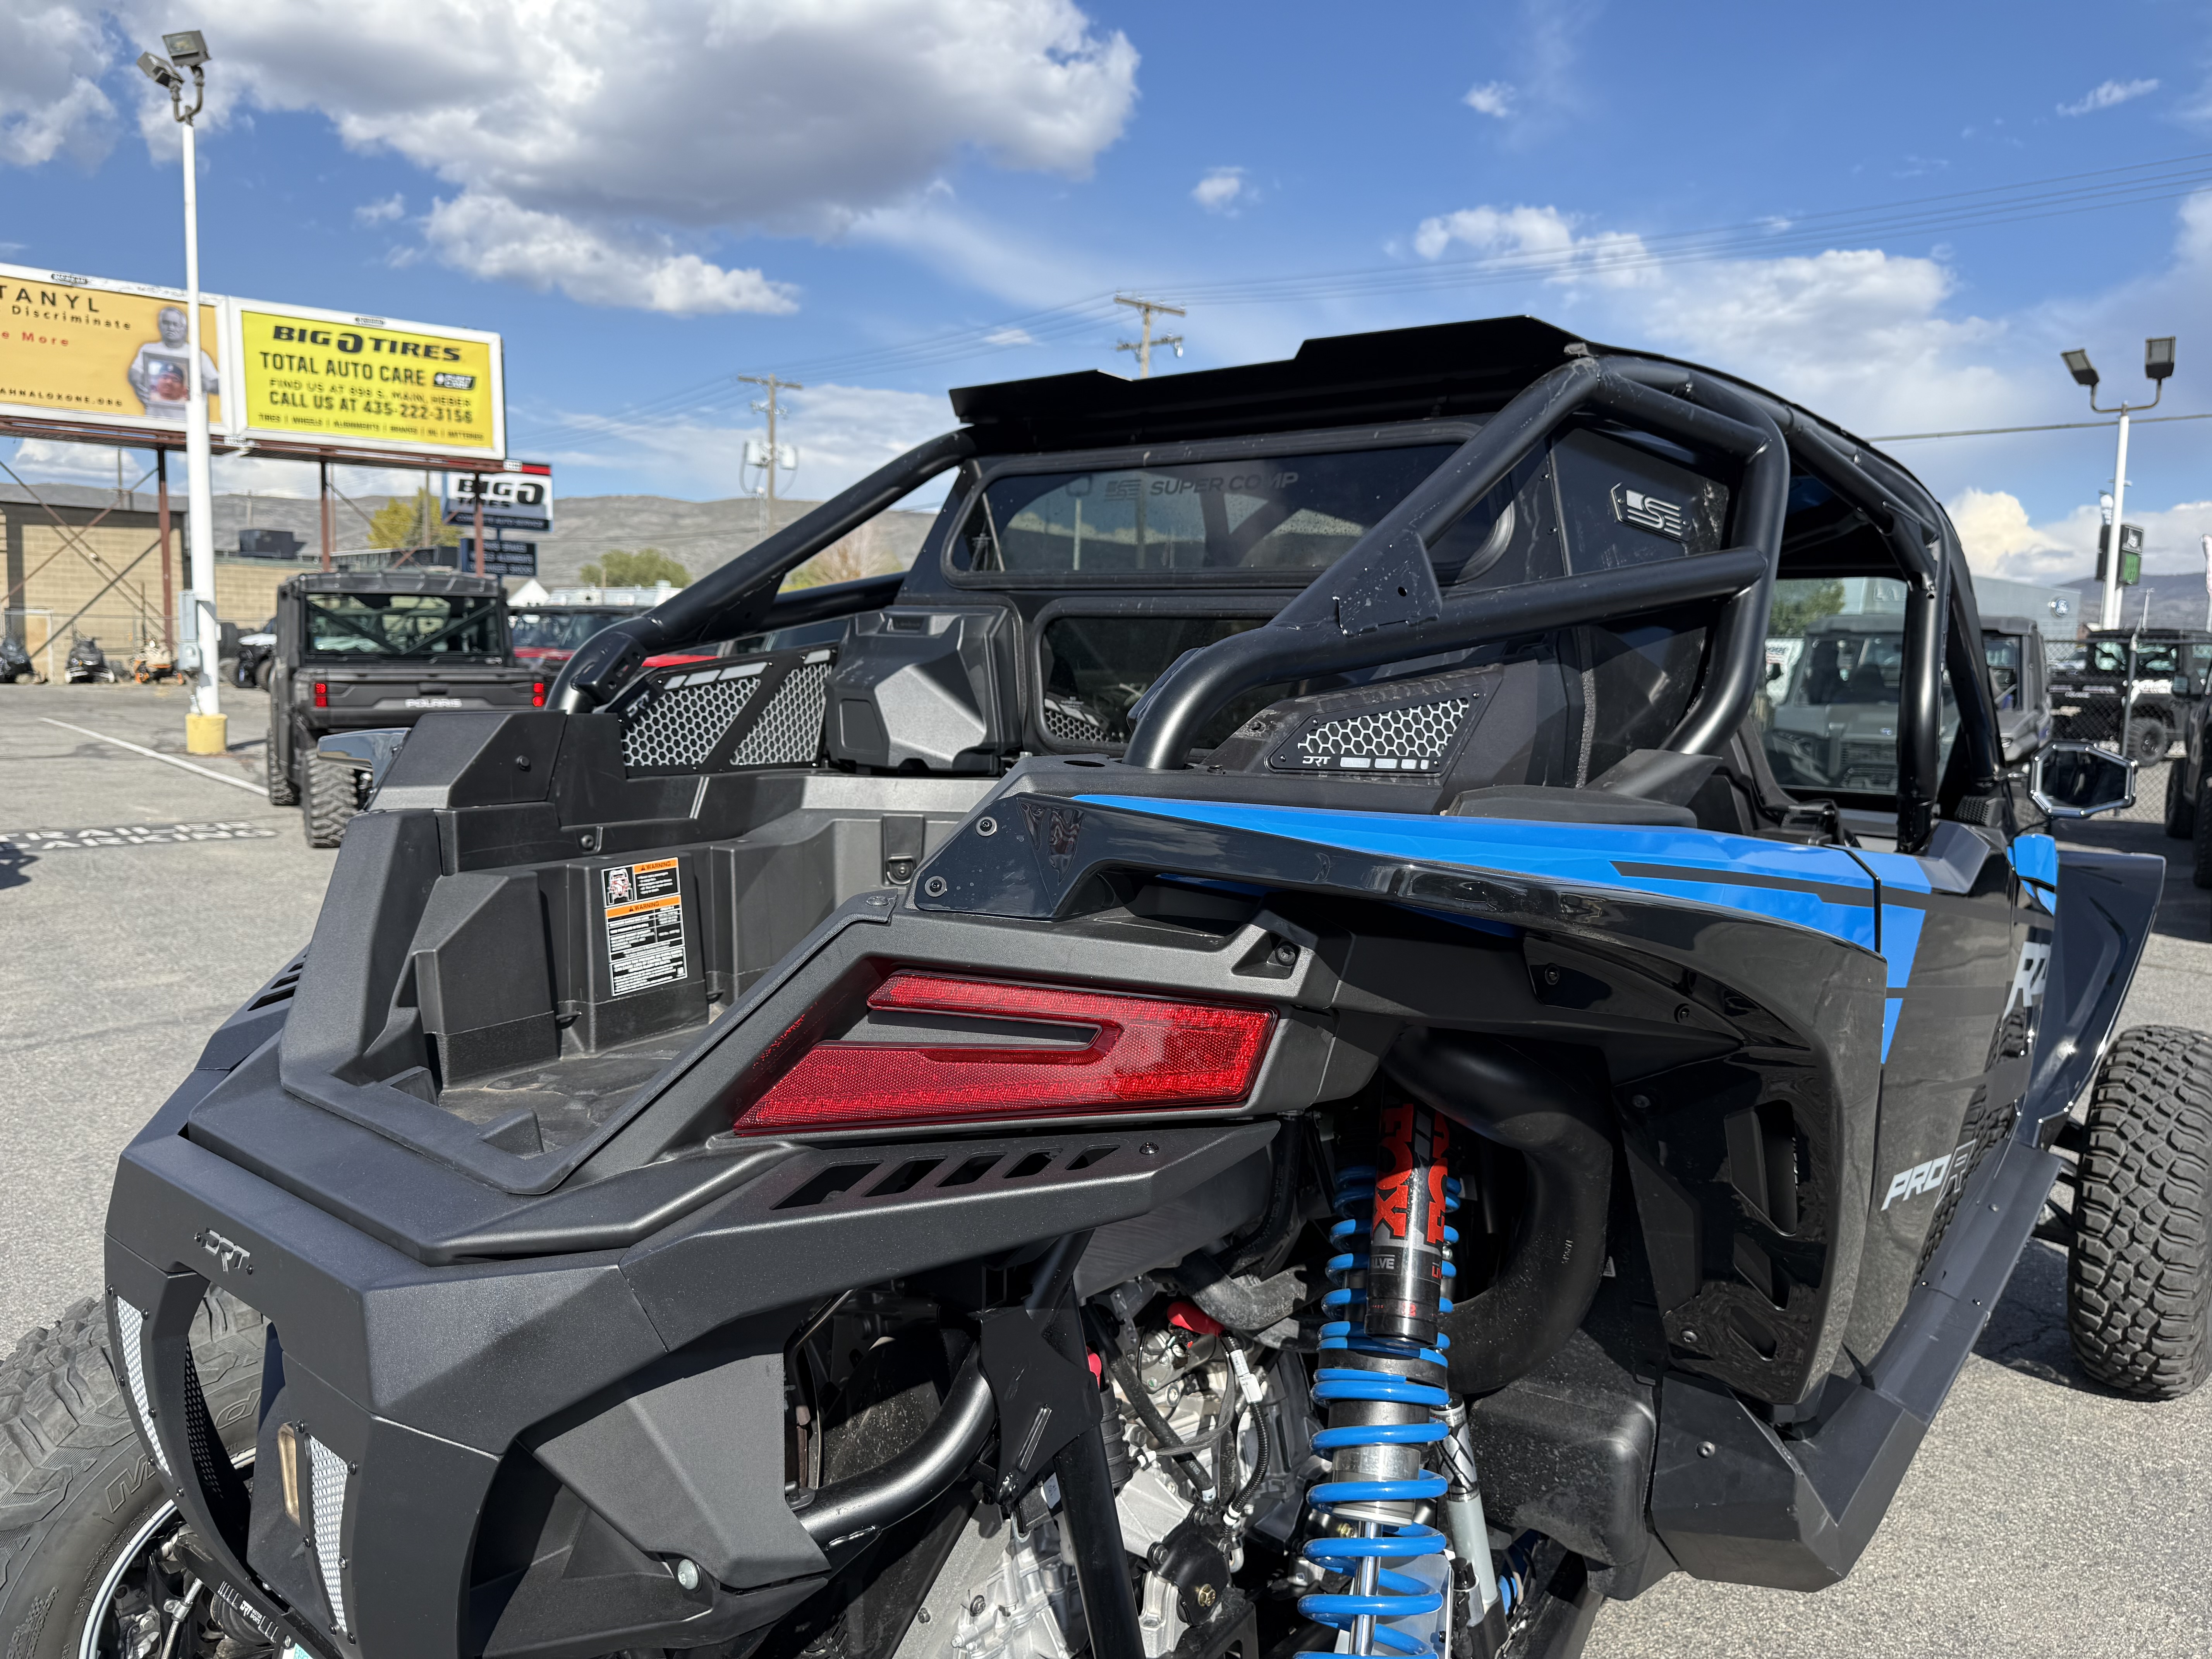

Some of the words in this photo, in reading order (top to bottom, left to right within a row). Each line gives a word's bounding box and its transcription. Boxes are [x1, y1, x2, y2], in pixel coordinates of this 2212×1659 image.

[12, 305, 131, 330] Discriminate
[22, 331, 69, 346] More
[273, 326, 332, 345] BIG
[369, 337, 461, 361] TIRES
[259, 351, 318, 374] TOTAL
[326, 360, 372, 379] AUTO
[380, 366, 425, 386] CARE
[270, 378, 302, 390] FIND
[307, 381, 323, 392] US
[330, 385, 344, 393] AT
[270, 390, 307, 407] CALL
[313, 395, 334, 410] US
[340, 398, 357, 412] AT
[1149, 477, 1224, 496] SUPER
[1228, 472, 1299, 491] COMP
[405, 699, 462, 708] POLARIS
[646, 861, 671, 870] WARNING
[635, 901, 659, 910] WARNING
[1881, 1153, 1952, 1211] PRO
[75, 1596, 88, 1614] FOR
[84, 1577, 97, 1592] ATV
[115, 1528, 130, 1545] USE
[130, 1505, 149, 1526] ONLY
[250, 1613, 261, 1625] SPORTS
[252, 1608, 263, 1619] MOTOR
